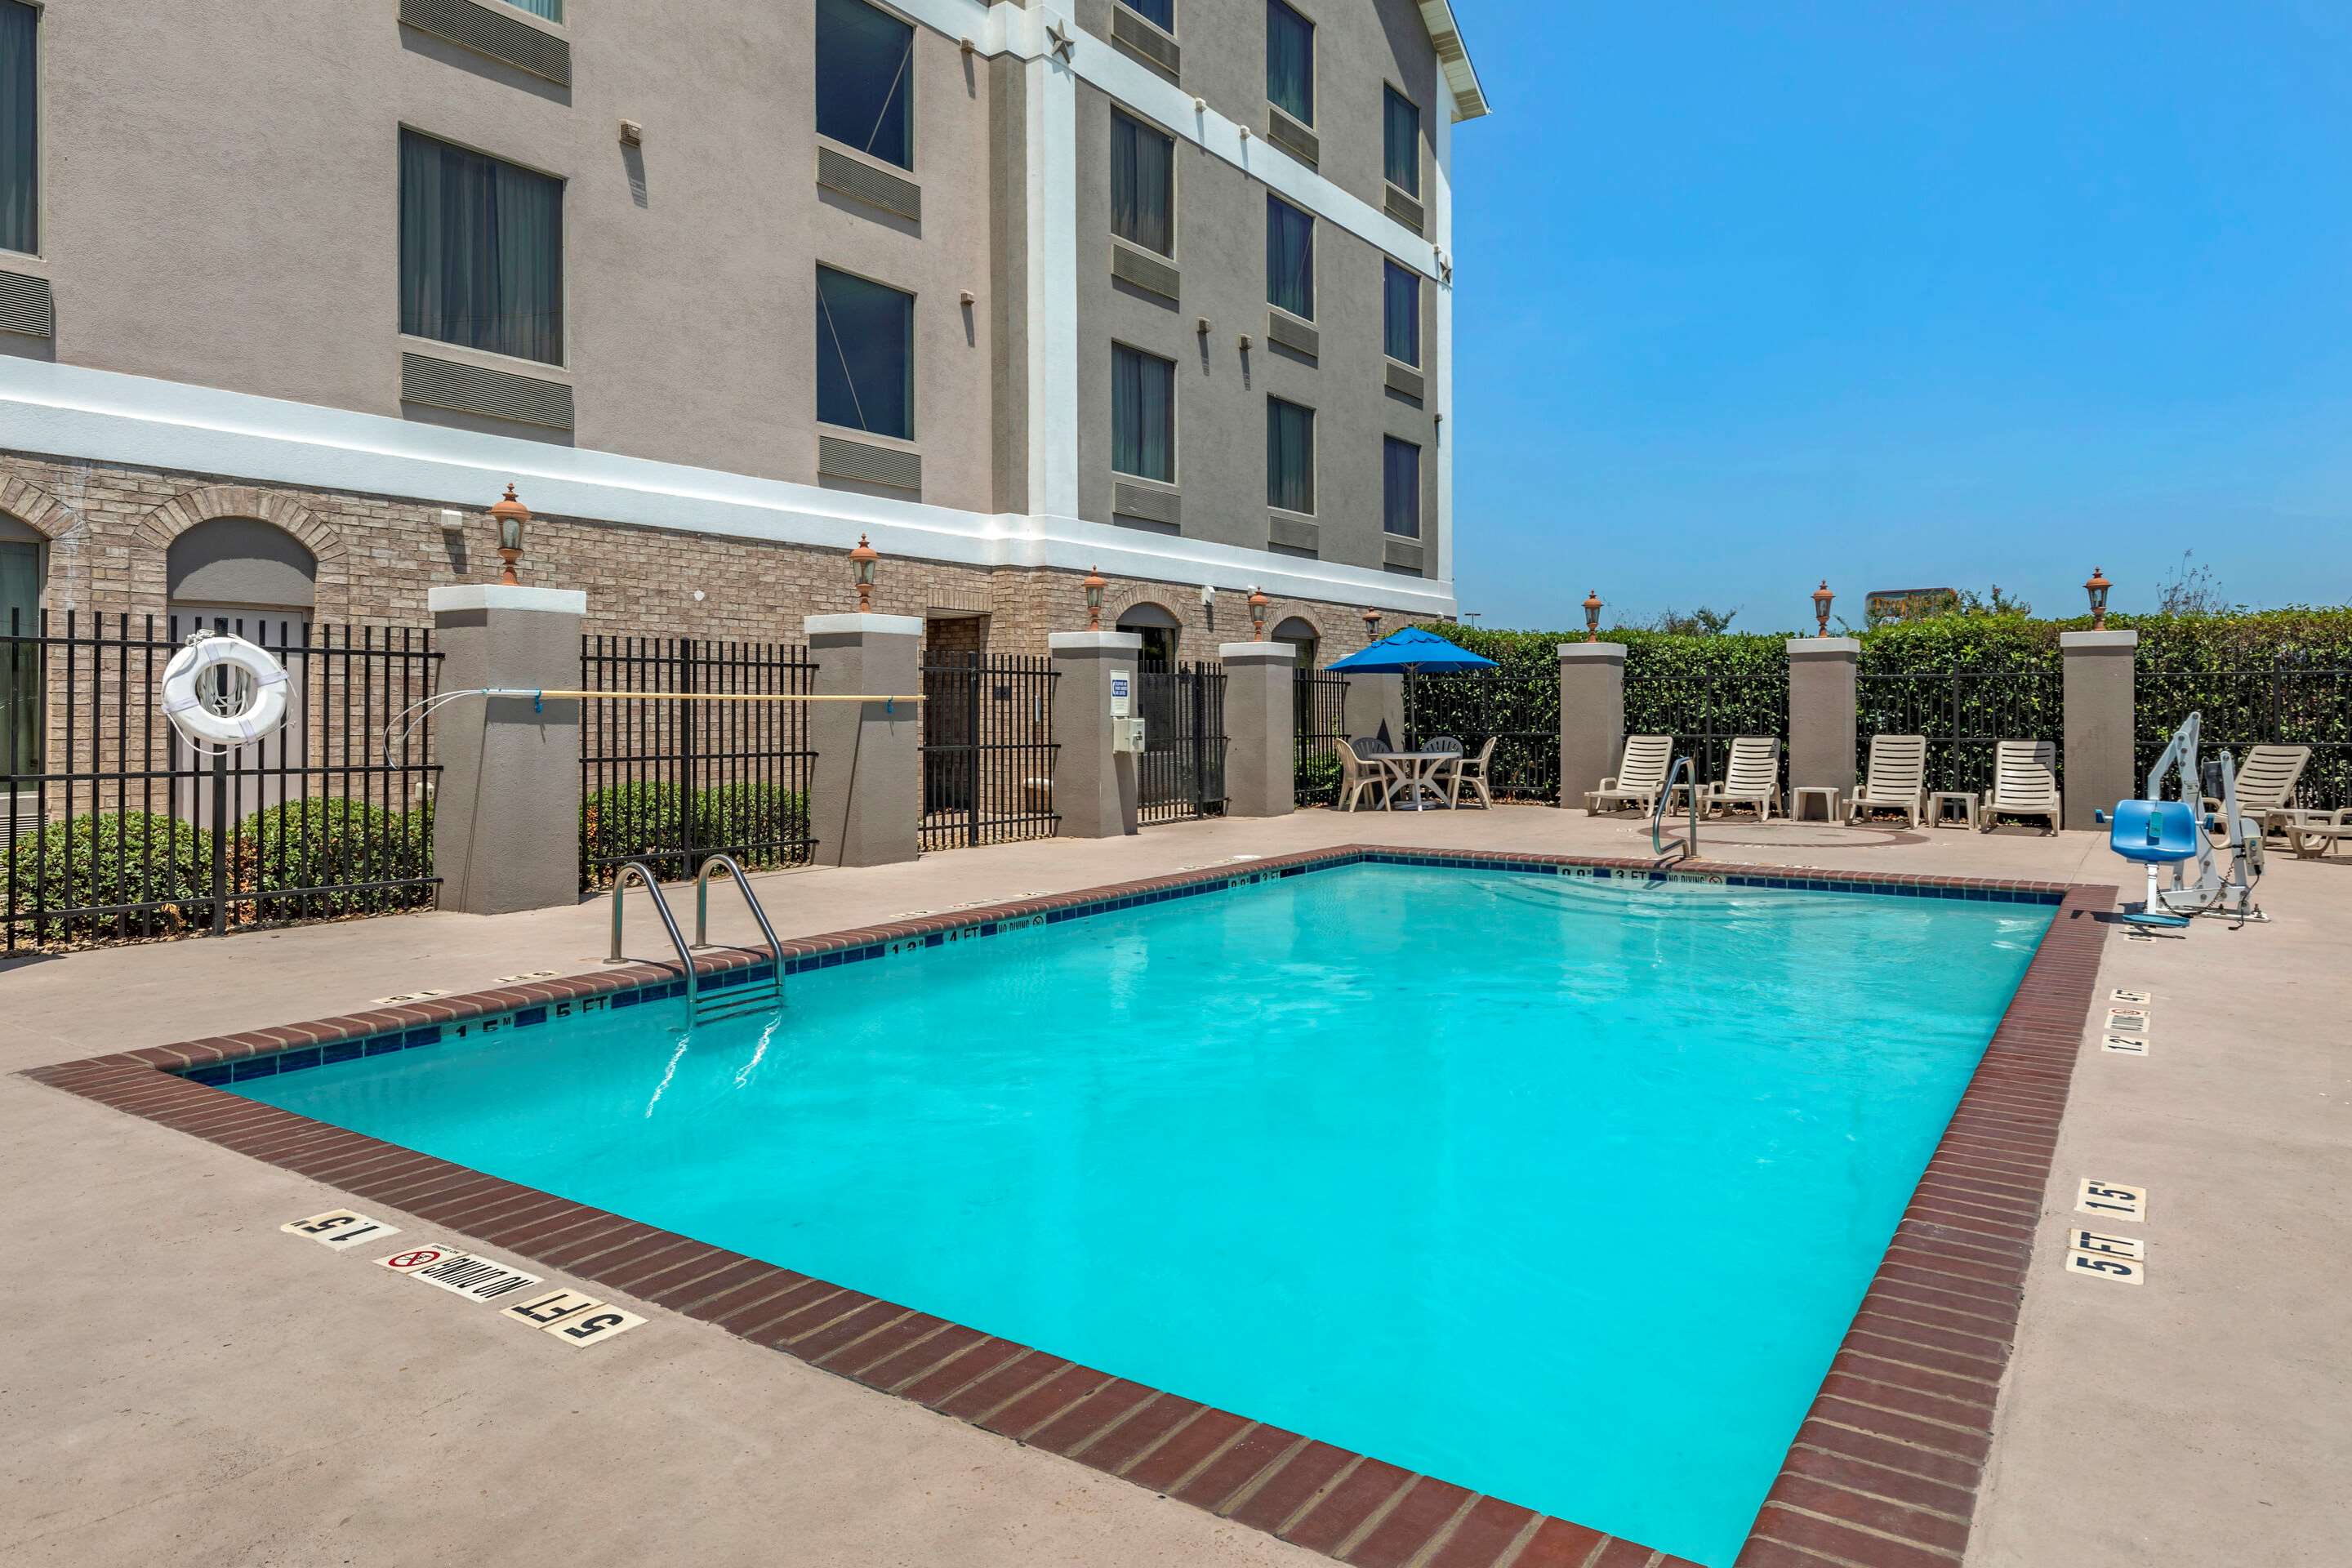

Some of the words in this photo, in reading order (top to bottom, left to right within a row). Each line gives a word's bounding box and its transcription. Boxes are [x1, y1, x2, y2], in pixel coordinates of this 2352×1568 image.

[1616, 870, 1624, 879] 3
[964, 926, 979, 939] FT
[999, 924, 1008, 935] NO
[1009, 919, 1030, 932] DIVING
[556, 1002, 571, 1018] 5
[582, 996, 608, 1013] FT
[421, 1257, 509, 1289] DIVING
[472, 1276, 535, 1298] NO
